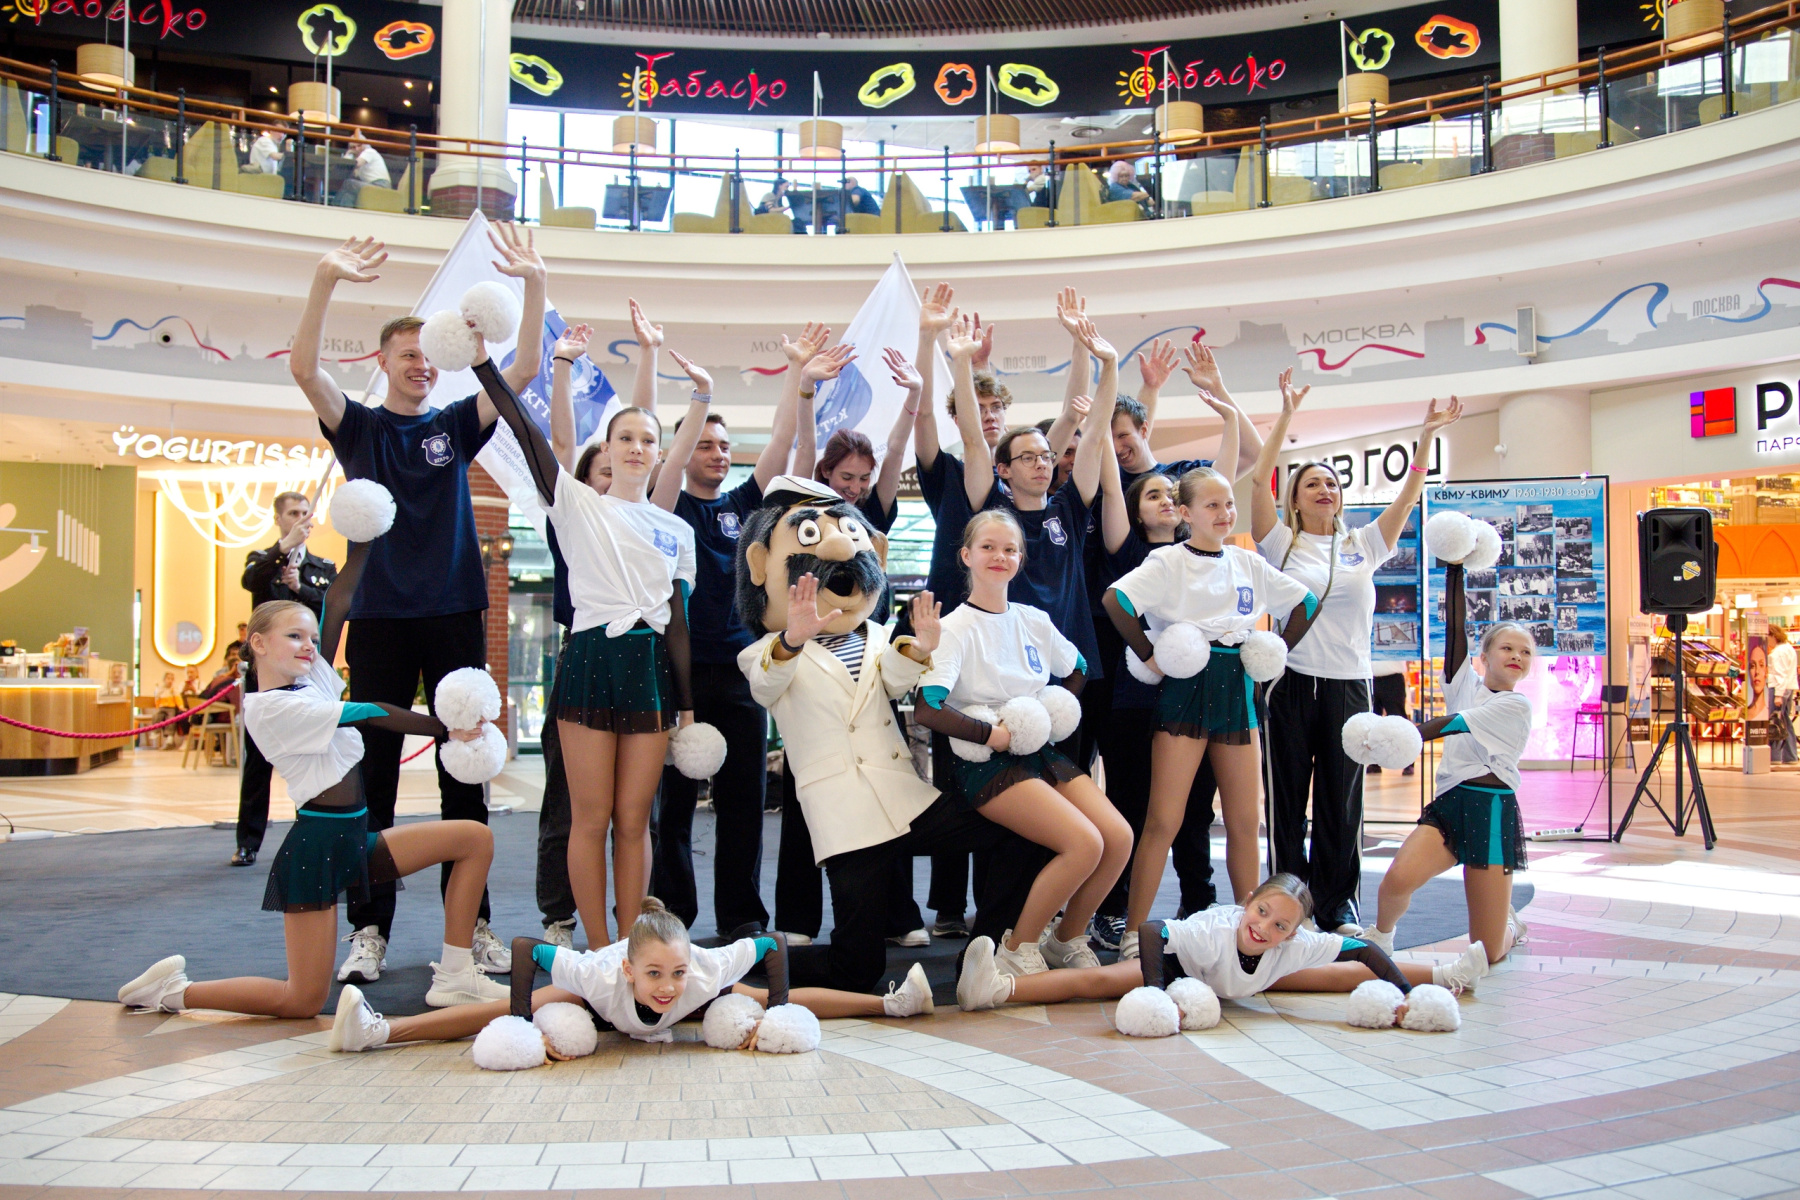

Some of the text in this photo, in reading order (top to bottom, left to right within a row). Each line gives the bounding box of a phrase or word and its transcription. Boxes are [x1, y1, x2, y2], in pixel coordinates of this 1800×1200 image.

[635, 52, 787, 111] Табаско
[1131, 45, 1286, 104] Табаско
[1691, 294, 1741, 317] МОСКВА
[1303, 322, 1415, 346] МОСКВА
[1003, 355, 1047, 370] MOSCOW
[521, 388, 552, 424] КГТ
[1756, 379, 1800, 431] Р
[1434, 489, 1510, 501] КВМУ-КВИМУ
[1512, 487, 1564, 498] 1960-1980
